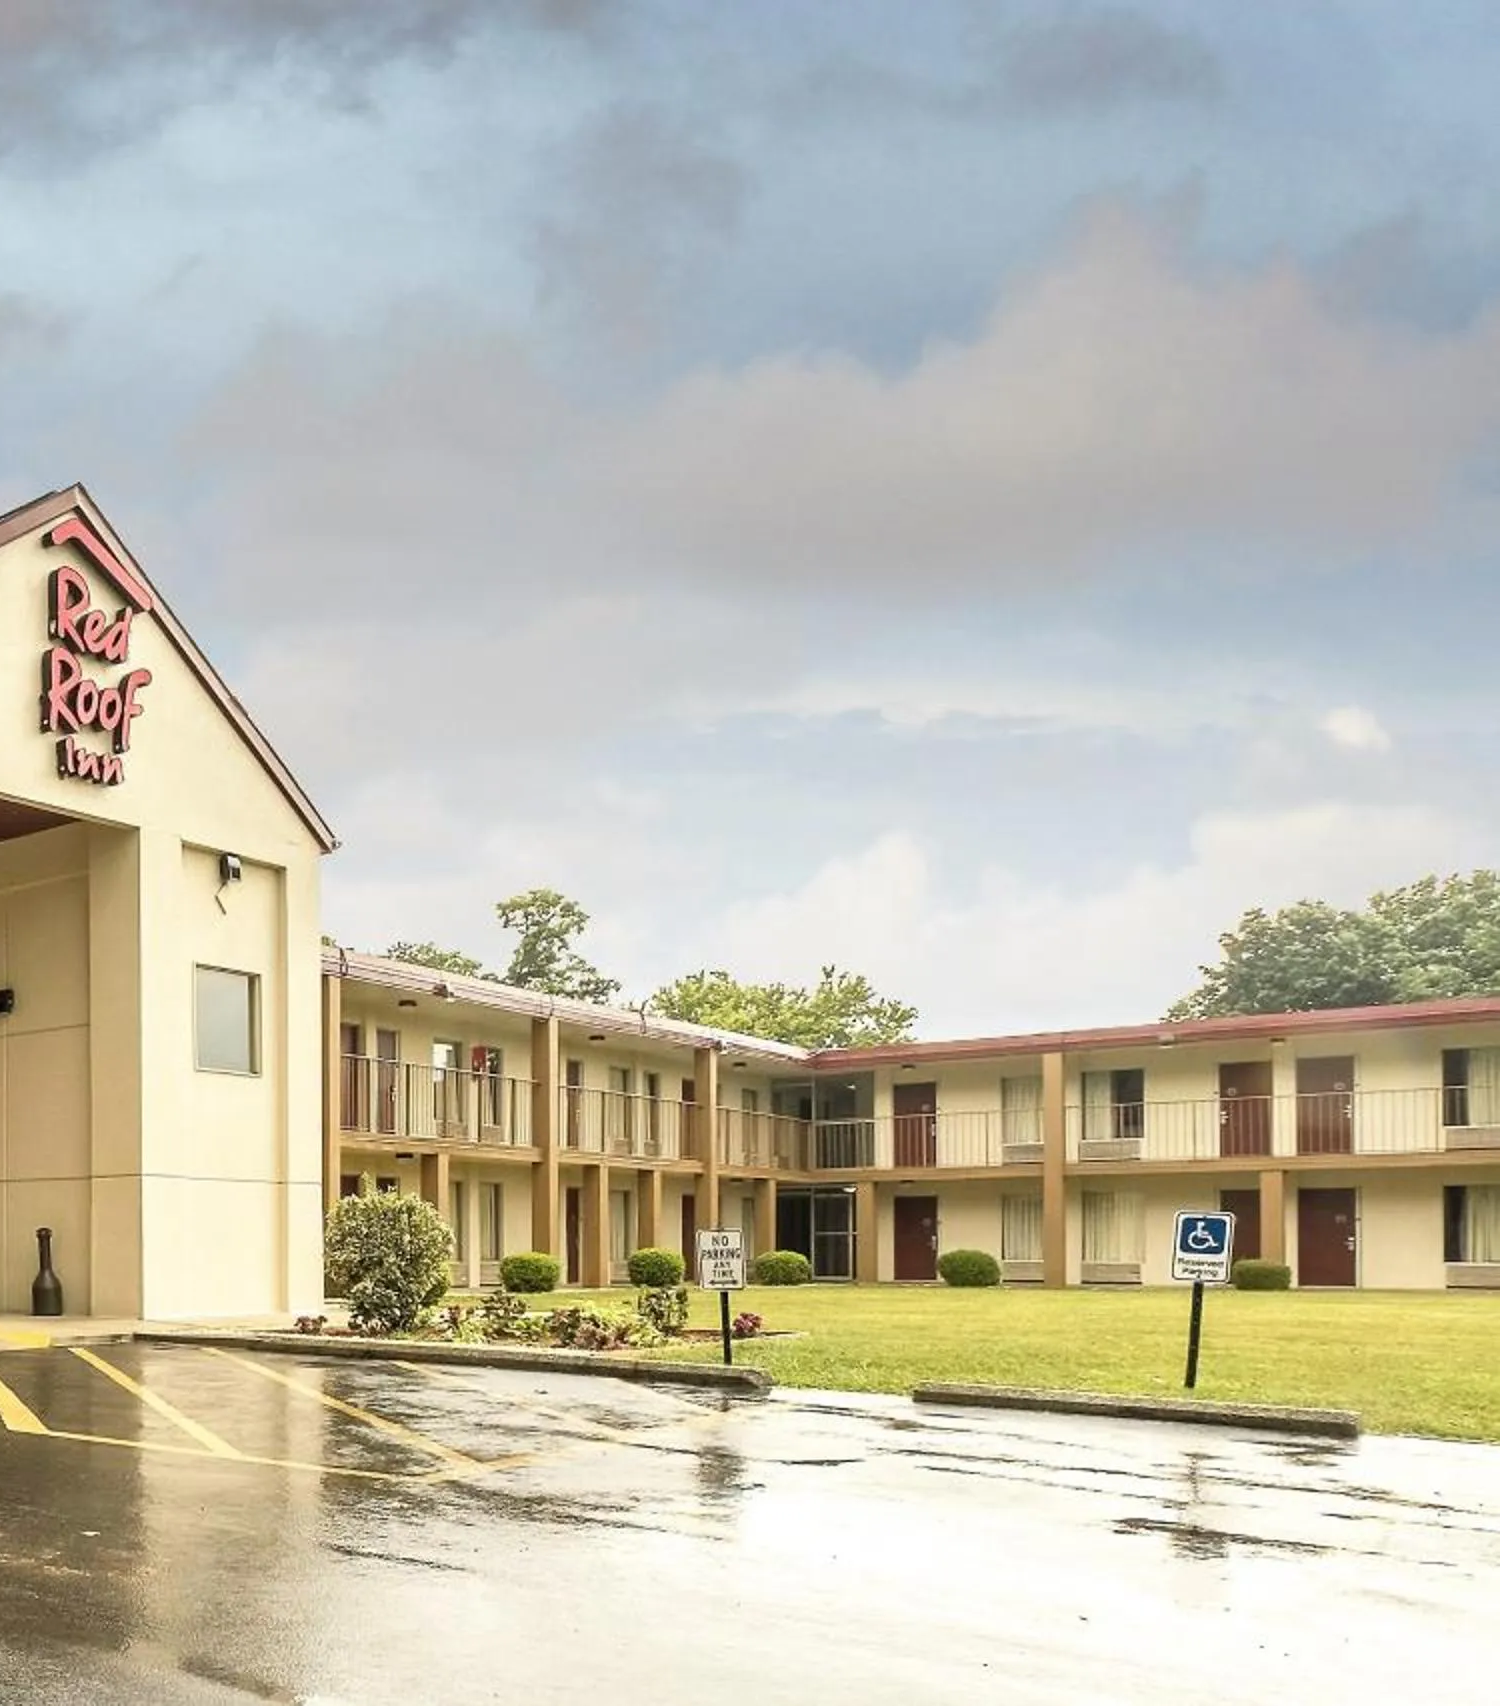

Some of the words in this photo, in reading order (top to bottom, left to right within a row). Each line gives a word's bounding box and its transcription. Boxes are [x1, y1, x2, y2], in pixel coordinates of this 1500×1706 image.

[48, 566, 132, 664] Red
[40, 647, 152, 753] Roof
[56, 736, 125, 786] Inn
[711, 1235, 729, 1247] NO
[701, 1248, 741, 1259] PARKING
[1177, 1257, 1225, 1267] Reserved
[712, 1270, 734, 1278] TIME
[1182, 1268, 1219, 1277] Parking
